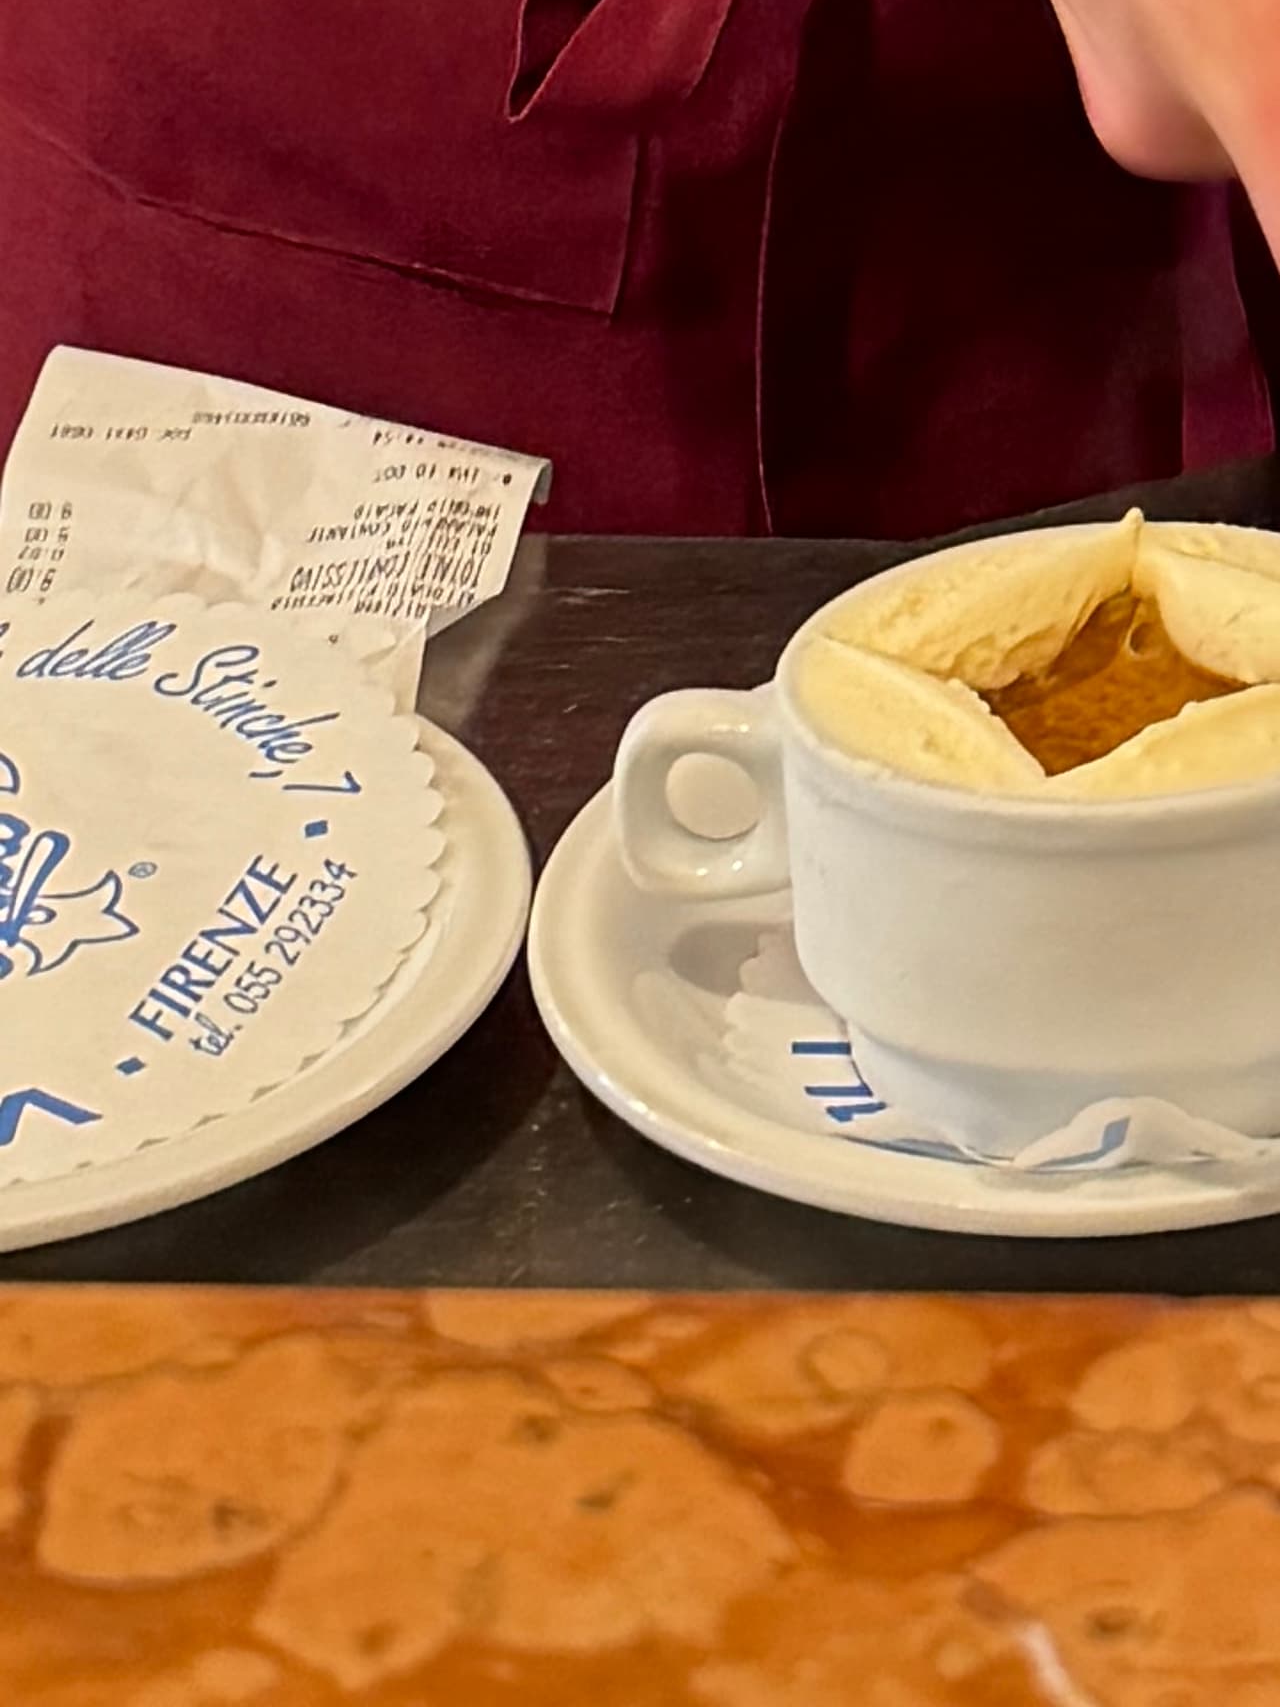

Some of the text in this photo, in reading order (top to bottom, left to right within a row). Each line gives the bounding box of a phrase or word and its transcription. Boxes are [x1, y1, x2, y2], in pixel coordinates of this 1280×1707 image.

[16, 619, 177, 682] delle
[128, 854, 298, 1041] FIRENZE
[224, 959, 283, 1017] 055
[267, 857, 358, 964] 292334
